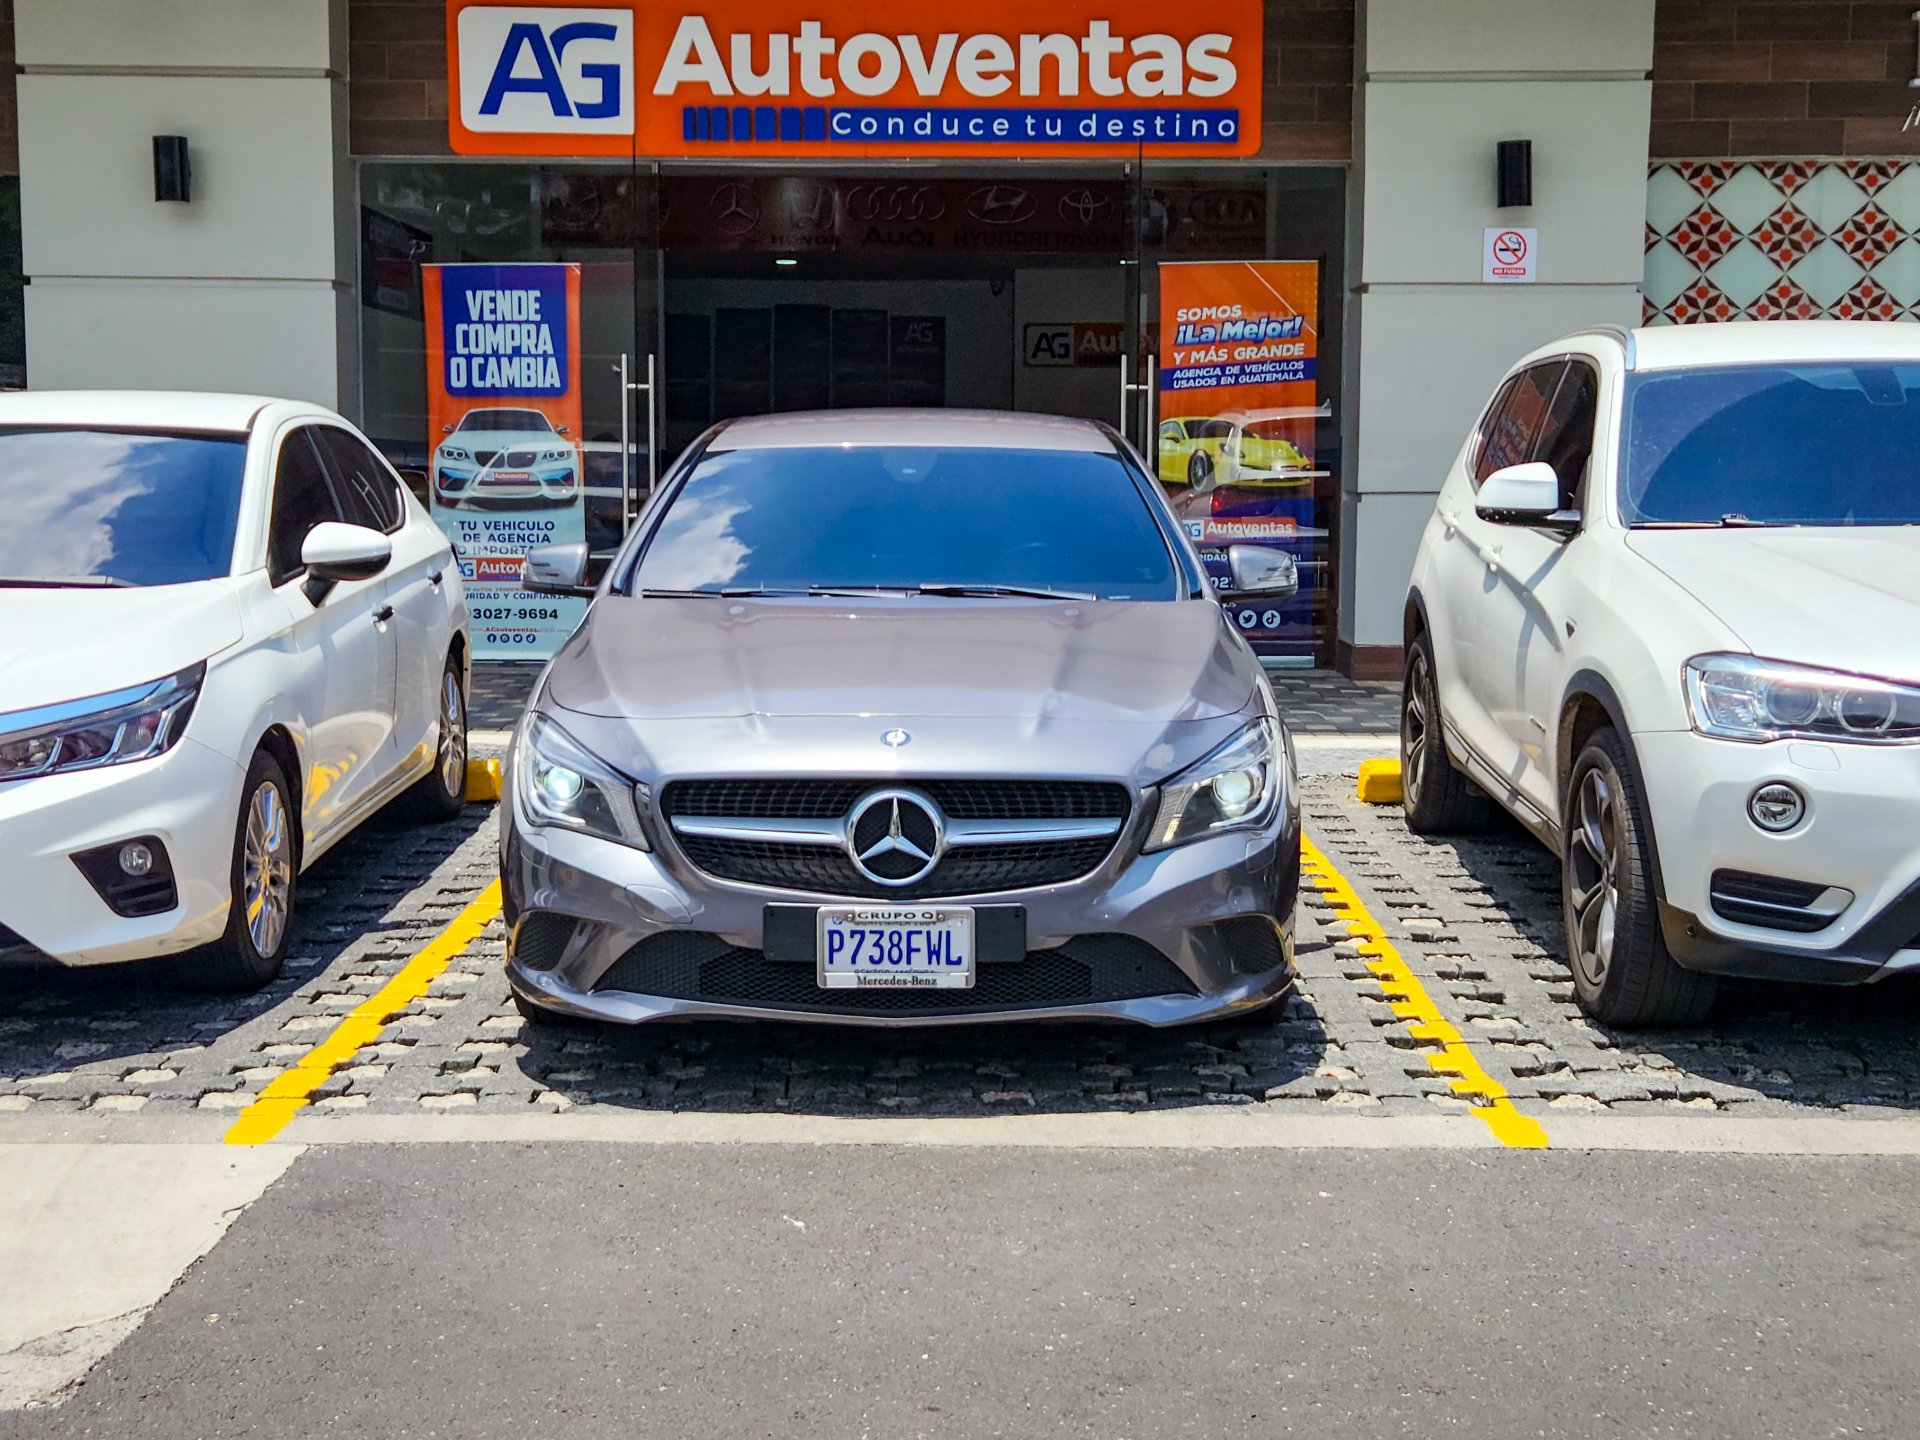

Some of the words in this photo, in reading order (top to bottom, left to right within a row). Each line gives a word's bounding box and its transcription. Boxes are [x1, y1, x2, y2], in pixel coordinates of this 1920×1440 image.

[653, 15, 1237, 97] Autoventas
[478, 22, 621, 119] AG
[831, 112, 1010, 137] Conduce
[1025, 113, 1063, 137] tu
[1079, 112, 1236, 138] destino
[465, 290, 541, 321] VENDE
[1176, 304, 1242, 322] SOMOS
[455, 323, 554, 355] COMPRA
[1175, 323, 1217, 345] ¡La
[1220, 315, 1305, 345] Mejor!
[1031, 332, 1071, 359] AG
[1173, 352, 1186, 365] Y
[1190, 346, 1228, 364] MÁS
[1233, 343, 1305, 360] GRANDE
[450, 357, 467, 388] O
[472, 357, 561, 388] CAMBIA
[1173, 367, 1222, 379] AGENCIA
[1226, 365, 1240, 374] DE
[1244, 361, 1304, 373] VEHÍCULOS
[1173, 377, 1217, 389] USADOS
[1220, 376, 1235, 385] EN
[1238, 372, 1304, 384] GUATEMALA
[459, 520, 477, 531] TU
[483, 520, 555, 531] VEHICULO
[1205, 521, 1293, 535] Autoventas
[463, 533, 481, 543] DE
[487, 533, 551, 543] AGENCIA
[472, 608, 559, 620] 3027-9694
[857, 911, 917, 920] GRUPO
[921, 911, 934, 920] Q
[827, 929, 963, 966] P738FWL
[857, 975, 938, 986] Mercedes-Benz
